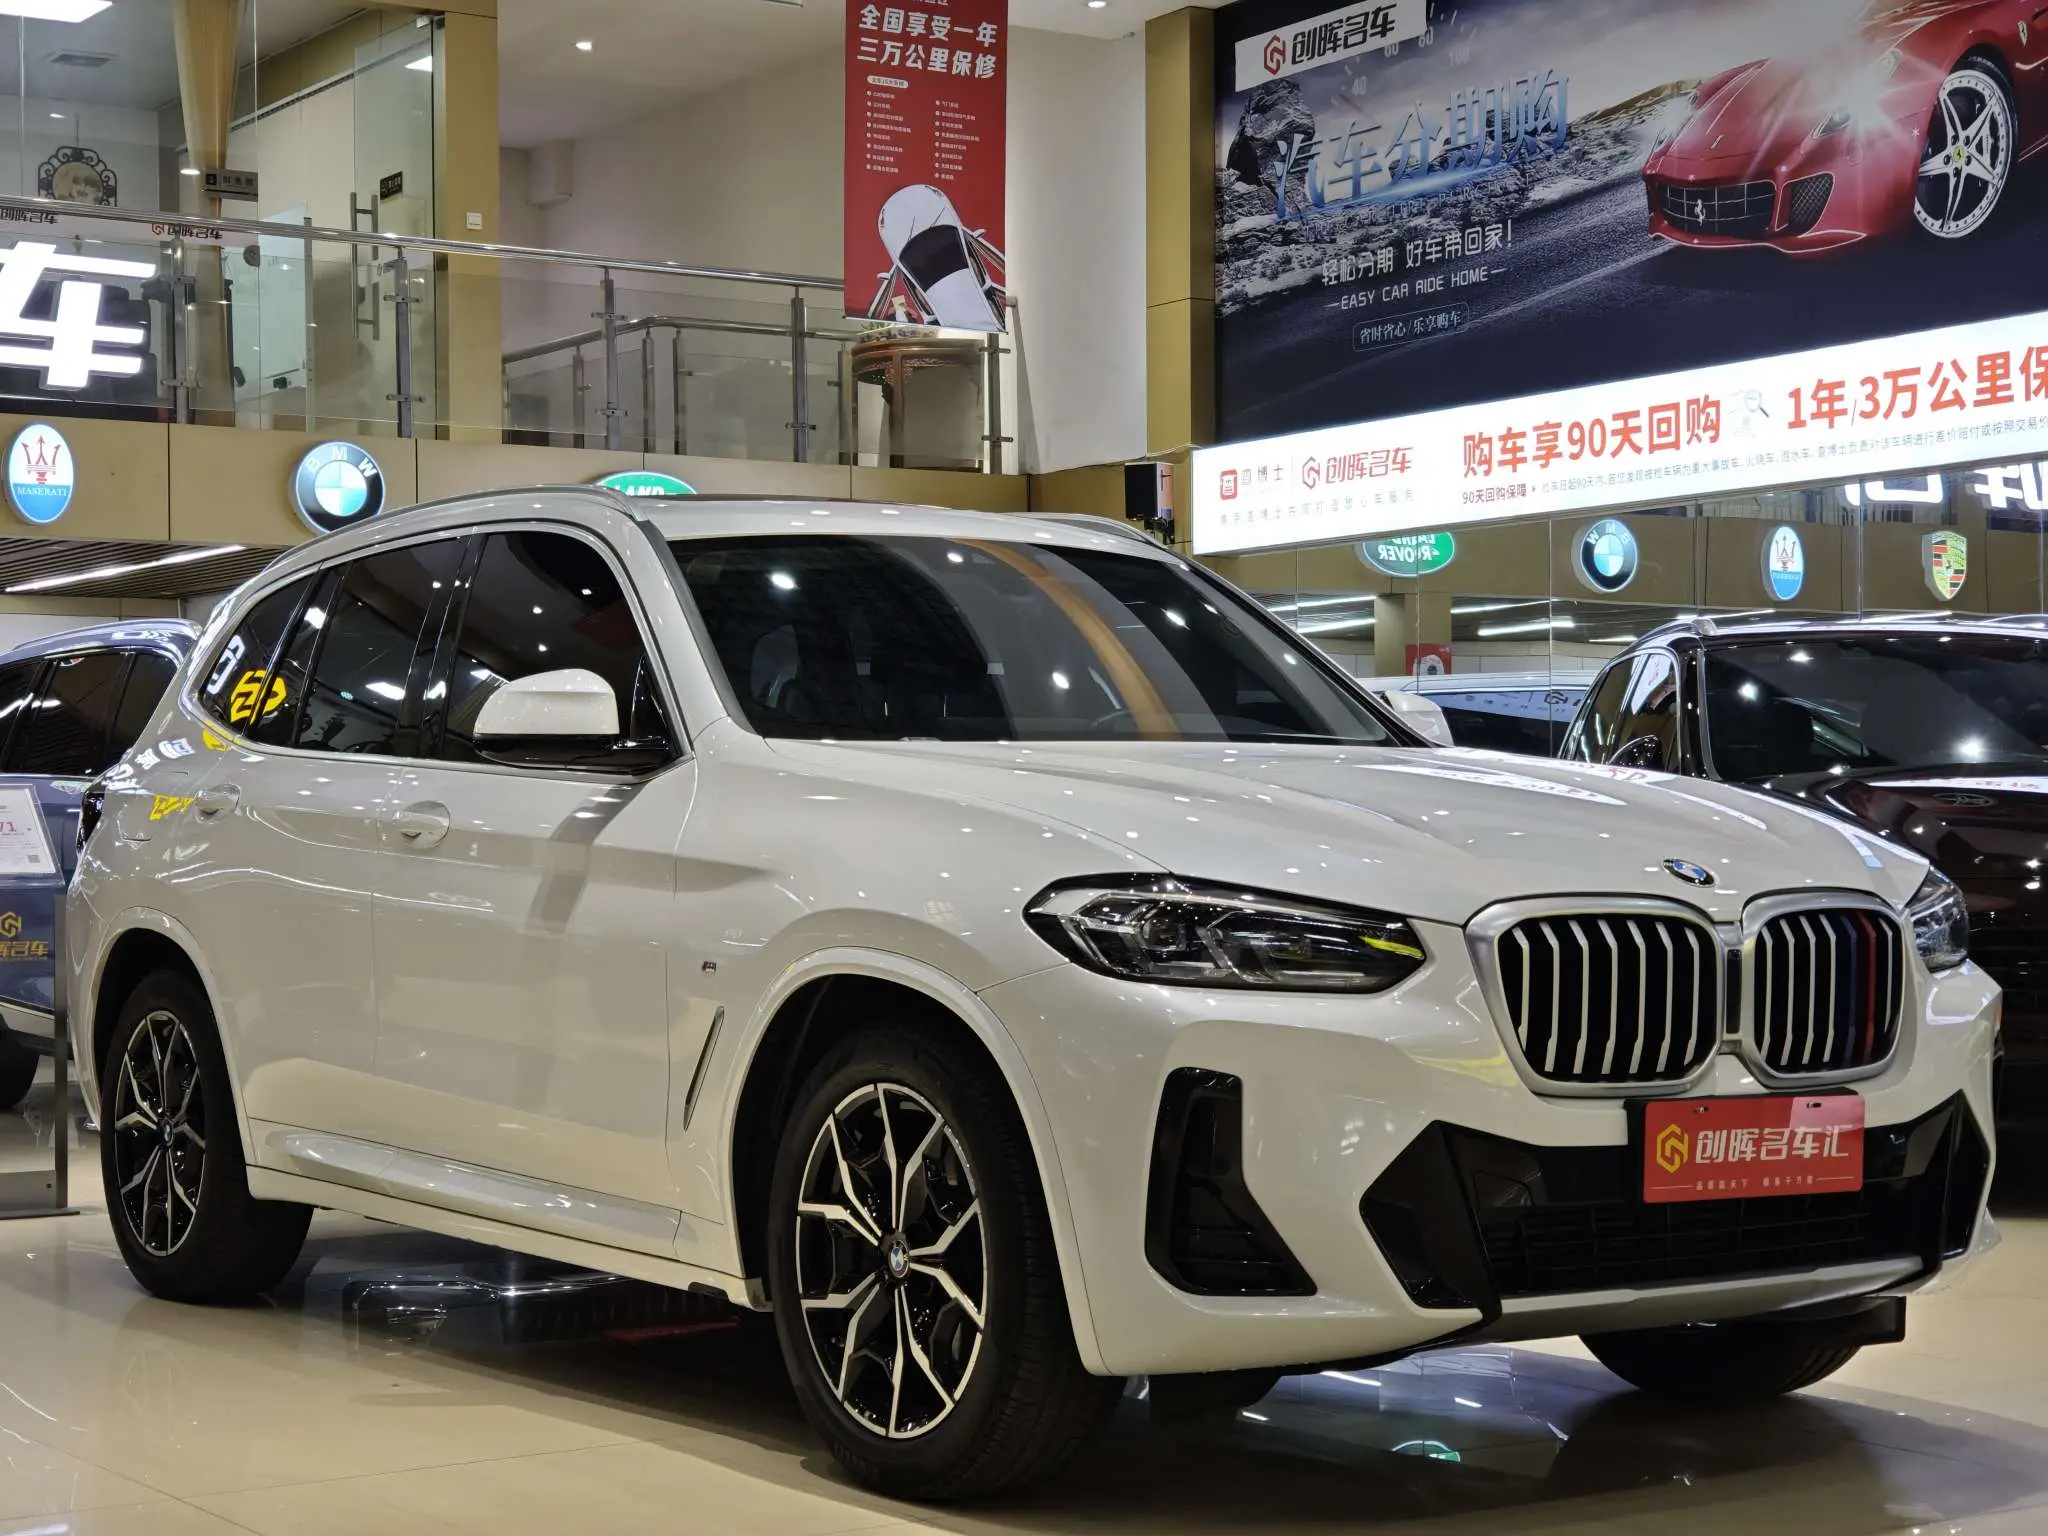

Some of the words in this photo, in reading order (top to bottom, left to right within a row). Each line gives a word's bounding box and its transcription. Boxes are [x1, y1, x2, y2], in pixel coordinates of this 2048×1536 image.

[858, 3, 998, 47] 全国享受一年
[1291, 3, 1397, 66] 创晖名车
[856, 36, 997, 79] 三万公里保修
[1273, 69, 1570, 221] 汽车分期购
[1321, 246, 1394, 287] 轻松分期
[1341, 290, 1376, 310] EASY
[1382, 283, 1409, 302] CAR
[1415, 275, 1445, 296] RIDE
[1451, 266, 1489, 287] HOME
[0, 241, 157, 388] 车
[1463, 394, 1721, 478] 购车享90天回购
[305, 446, 377, 478] BMW
[1326, 447, 1414, 484] 创晖名车
[17, 487, 68, 497] MASERATI
[1462, 483, 1527, 504] 90天回购保障
[1695, 1124, 1854, 1164] 创晖名车汇
